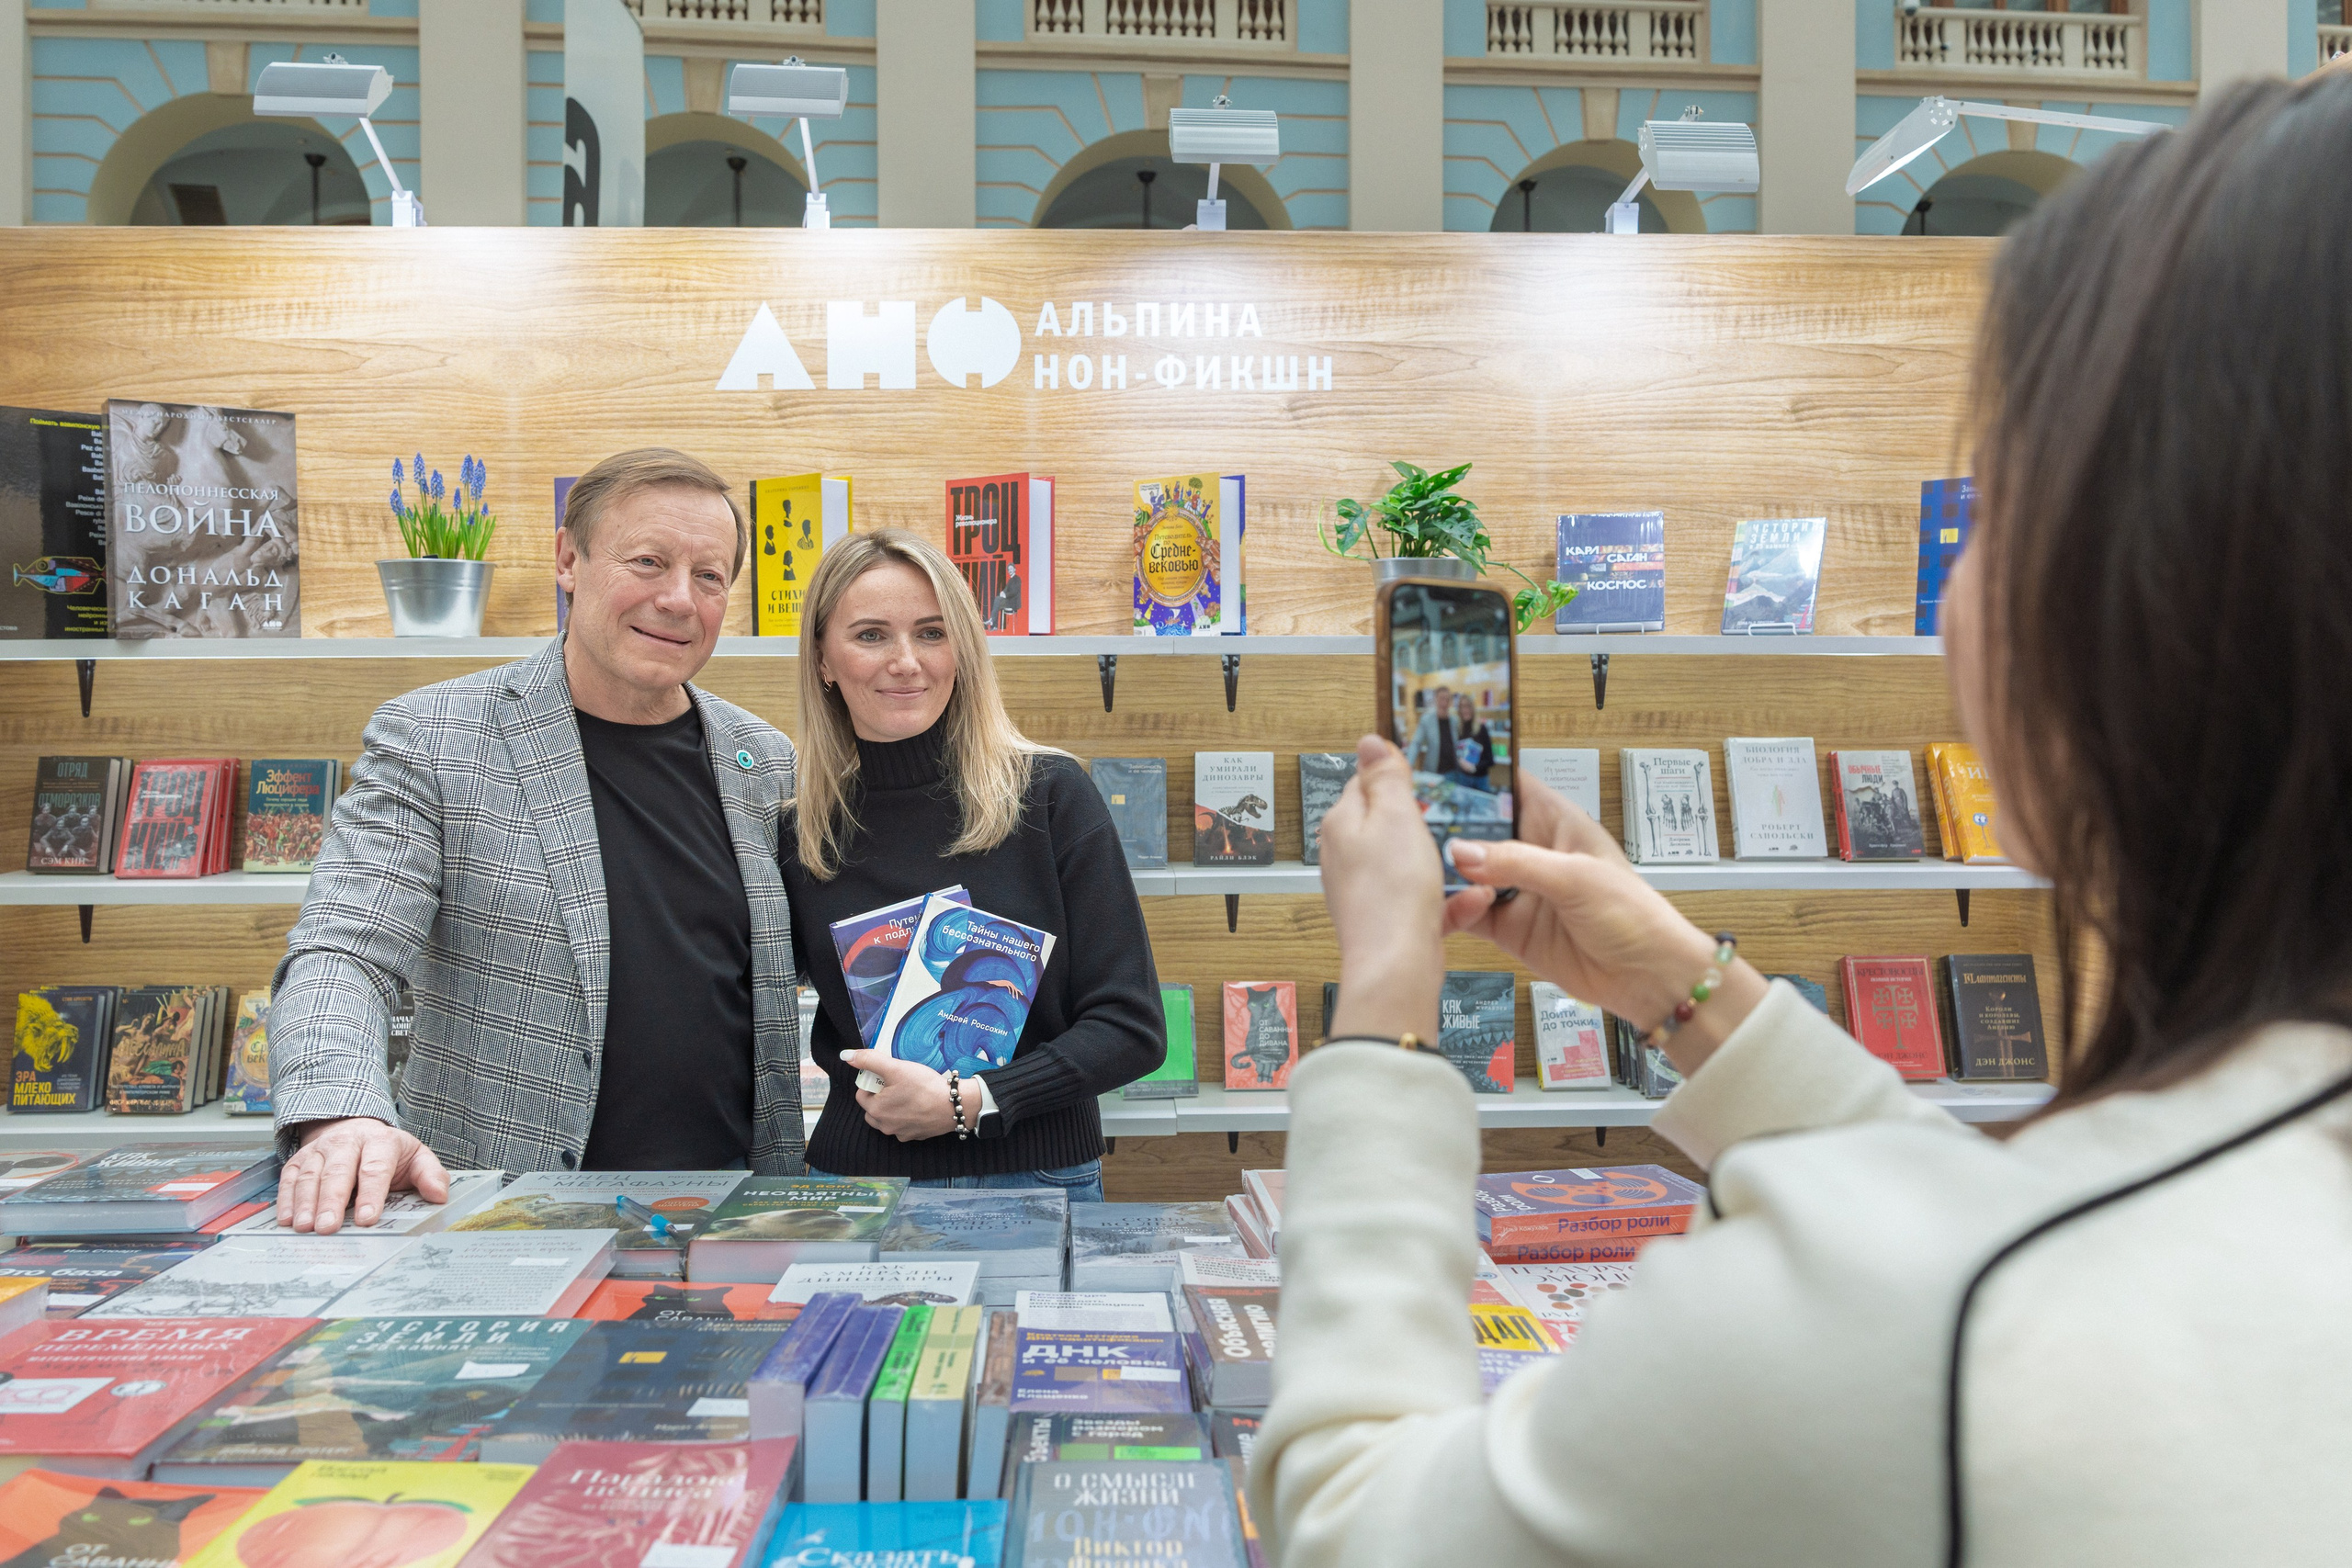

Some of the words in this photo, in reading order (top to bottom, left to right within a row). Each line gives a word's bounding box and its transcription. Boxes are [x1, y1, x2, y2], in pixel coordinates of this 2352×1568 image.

[1034, 301, 1264, 338] АЛЬПИНА
[1034, 354, 1333, 390] НОН-ФИКШН
[124, 483, 278, 501] ПЕЛОПОННЕССКАЯ
[125, 501, 284, 538] ВОЙНА
[950, 481, 1021, 564] ТРОЦ
[1750, 532, 1801, 544] ЗЕМЛИ
[1150, 544, 1196, 560] Средне-
[1566, 546, 1600, 556] КАРЛ
[1607, 553, 1647, 563] САГАН
[1148, 559, 1199, 574] вековью
[127, 566, 283, 588] ДОНАЛЬД
[1587, 580, 1647, 591] КОСМОС
[129, 591, 283, 612] КАГАН
[1746, 746, 1800, 754] БИОЛОГИЯ
[1654, 757, 1691, 768] Первые
[57, 762, 88, 778] ОТРЯД
[1209, 765, 1258, 773] УМИРАЛИ
[1660, 767, 1686, 775] шаги
[1848, 764, 1883, 774] ОБЫЧНЫЕ
[266, 770, 313, 785] Эффект
[1202, 773, 1264, 783] ДИНОЗАВРЫ
[1861, 773, 1884, 784] ЛЮДИ
[255, 781, 321, 798] Люцифера
[39, 793, 101, 808] ОТМОРОЗКОВ
[1750, 832, 1815, 840] САПОЛЬСКИ
[40, 857, 62, 865] СЭМ
[874, 936, 882, 944] к
[967, 920, 999, 941] Тайны
[1002, 935, 1040, 953] нашего
[942, 926, 1037, 963] бессознательного
[1856, 967, 1925, 977] КРЕСТОНОСЦЫ
[1442, 999, 1463, 1014] КАК
[938, 1010, 969, 1026] Андрей
[970, 1019, 1009, 1037] Россохин
[1442, 1014, 1481, 1030] ЖИВЫЕ
[1543, 1021, 1558, 1032] до
[1975, 1058, 1996, 1067] ДЭН
[1997, 1057, 2036, 1066] ДЖОНС
[16, 1071, 37, 1082] ЭРА
[14, 1081, 52, 1094] МЛЕКО
[13, 1093, 76, 1106] ПИТАЮЩИХ
[103, 1152, 159, 1160] КАК
[96, 1158, 182, 1168] ЖИВЫЕ
[537, 1174, 631, 1182] КОНЕЦ
[553, 1179, 730, 1189] МЕГАФАУНЫ
[1557, 1216, 1623, 1235] Разбор
[1627, 1214, 1671, 1230] роли
[1518, 1246, 1585, 1262] Разбор
[1589, 1245, 1635, 1260] роли
[51, 1268, 124, 1278] база
[797, 1276, 953, 1284] ДИНОЗАВРЫ
[1206, 1297, 1252, 1359] Объясняя
[51, 1327, 258, 1342] ВРЕМЯ
[356, 1332, 511, 1344] ЗЕМЛИ
[32, 1342, 236, 1352] ПЕРЕМЕННЫХ
[1022, 1344, 1131, 1359] ДНК
[1044, 1357, 1069, 1365] её
[1078, 1359, 1168, 1367] человек
[1071, 1424, 1164, 1433] размером
[1088, 1430, 1144, 1438] город
[1074, 1487, 1180, 1506] ЖИЗНИ
[65, 1543, 109, 1556] ОТ
[1074, 1537, 1183, 1559] Виктор
[797, 1547, 961, 1568] Сказать
